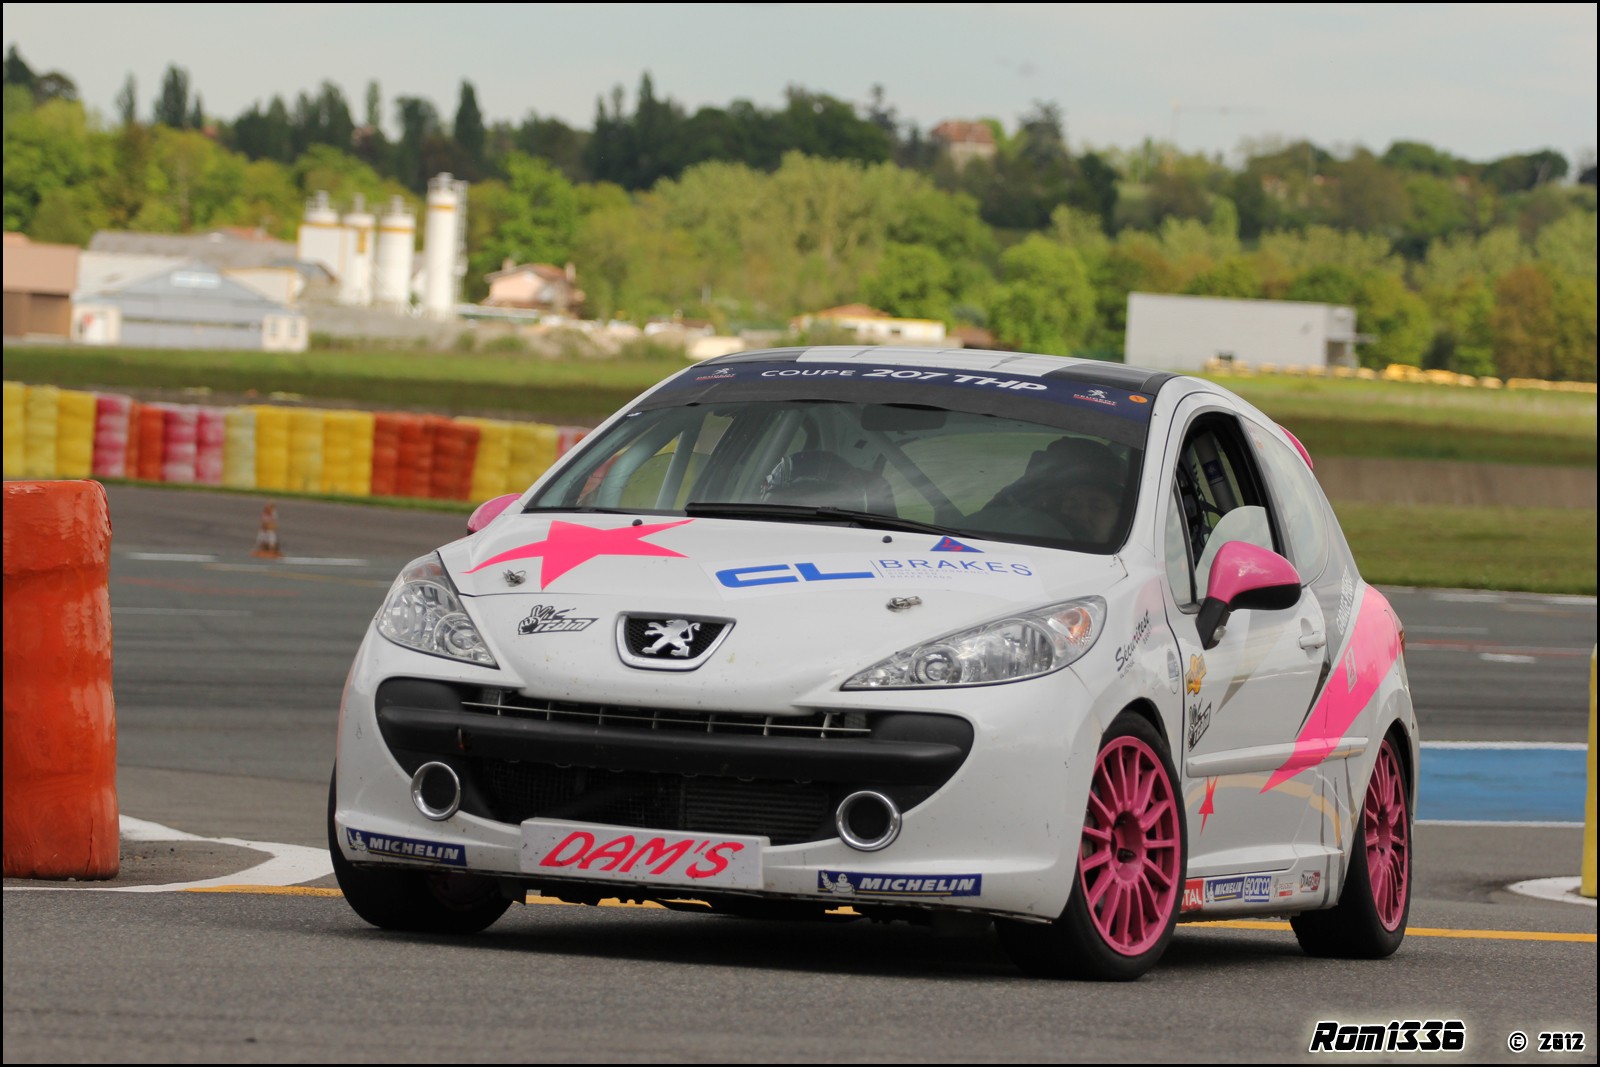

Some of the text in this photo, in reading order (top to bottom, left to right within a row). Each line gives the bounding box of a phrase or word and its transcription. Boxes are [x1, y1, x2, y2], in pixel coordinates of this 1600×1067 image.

[761, 369, 1047, 391] COUPE 207 THP
[715, 559, 1033, 588] CL BRAKES
[369, 837, 460, 861] MICHELIN
[538, 831, 746, 879] DAM'S
[859, 877, 976, 892] MICHELIN
[1214, 880, 1243, 896] MICHELIN
[1245, 877, 1270, 896] sparco
[1181, 886, 1203, 906] TAL
